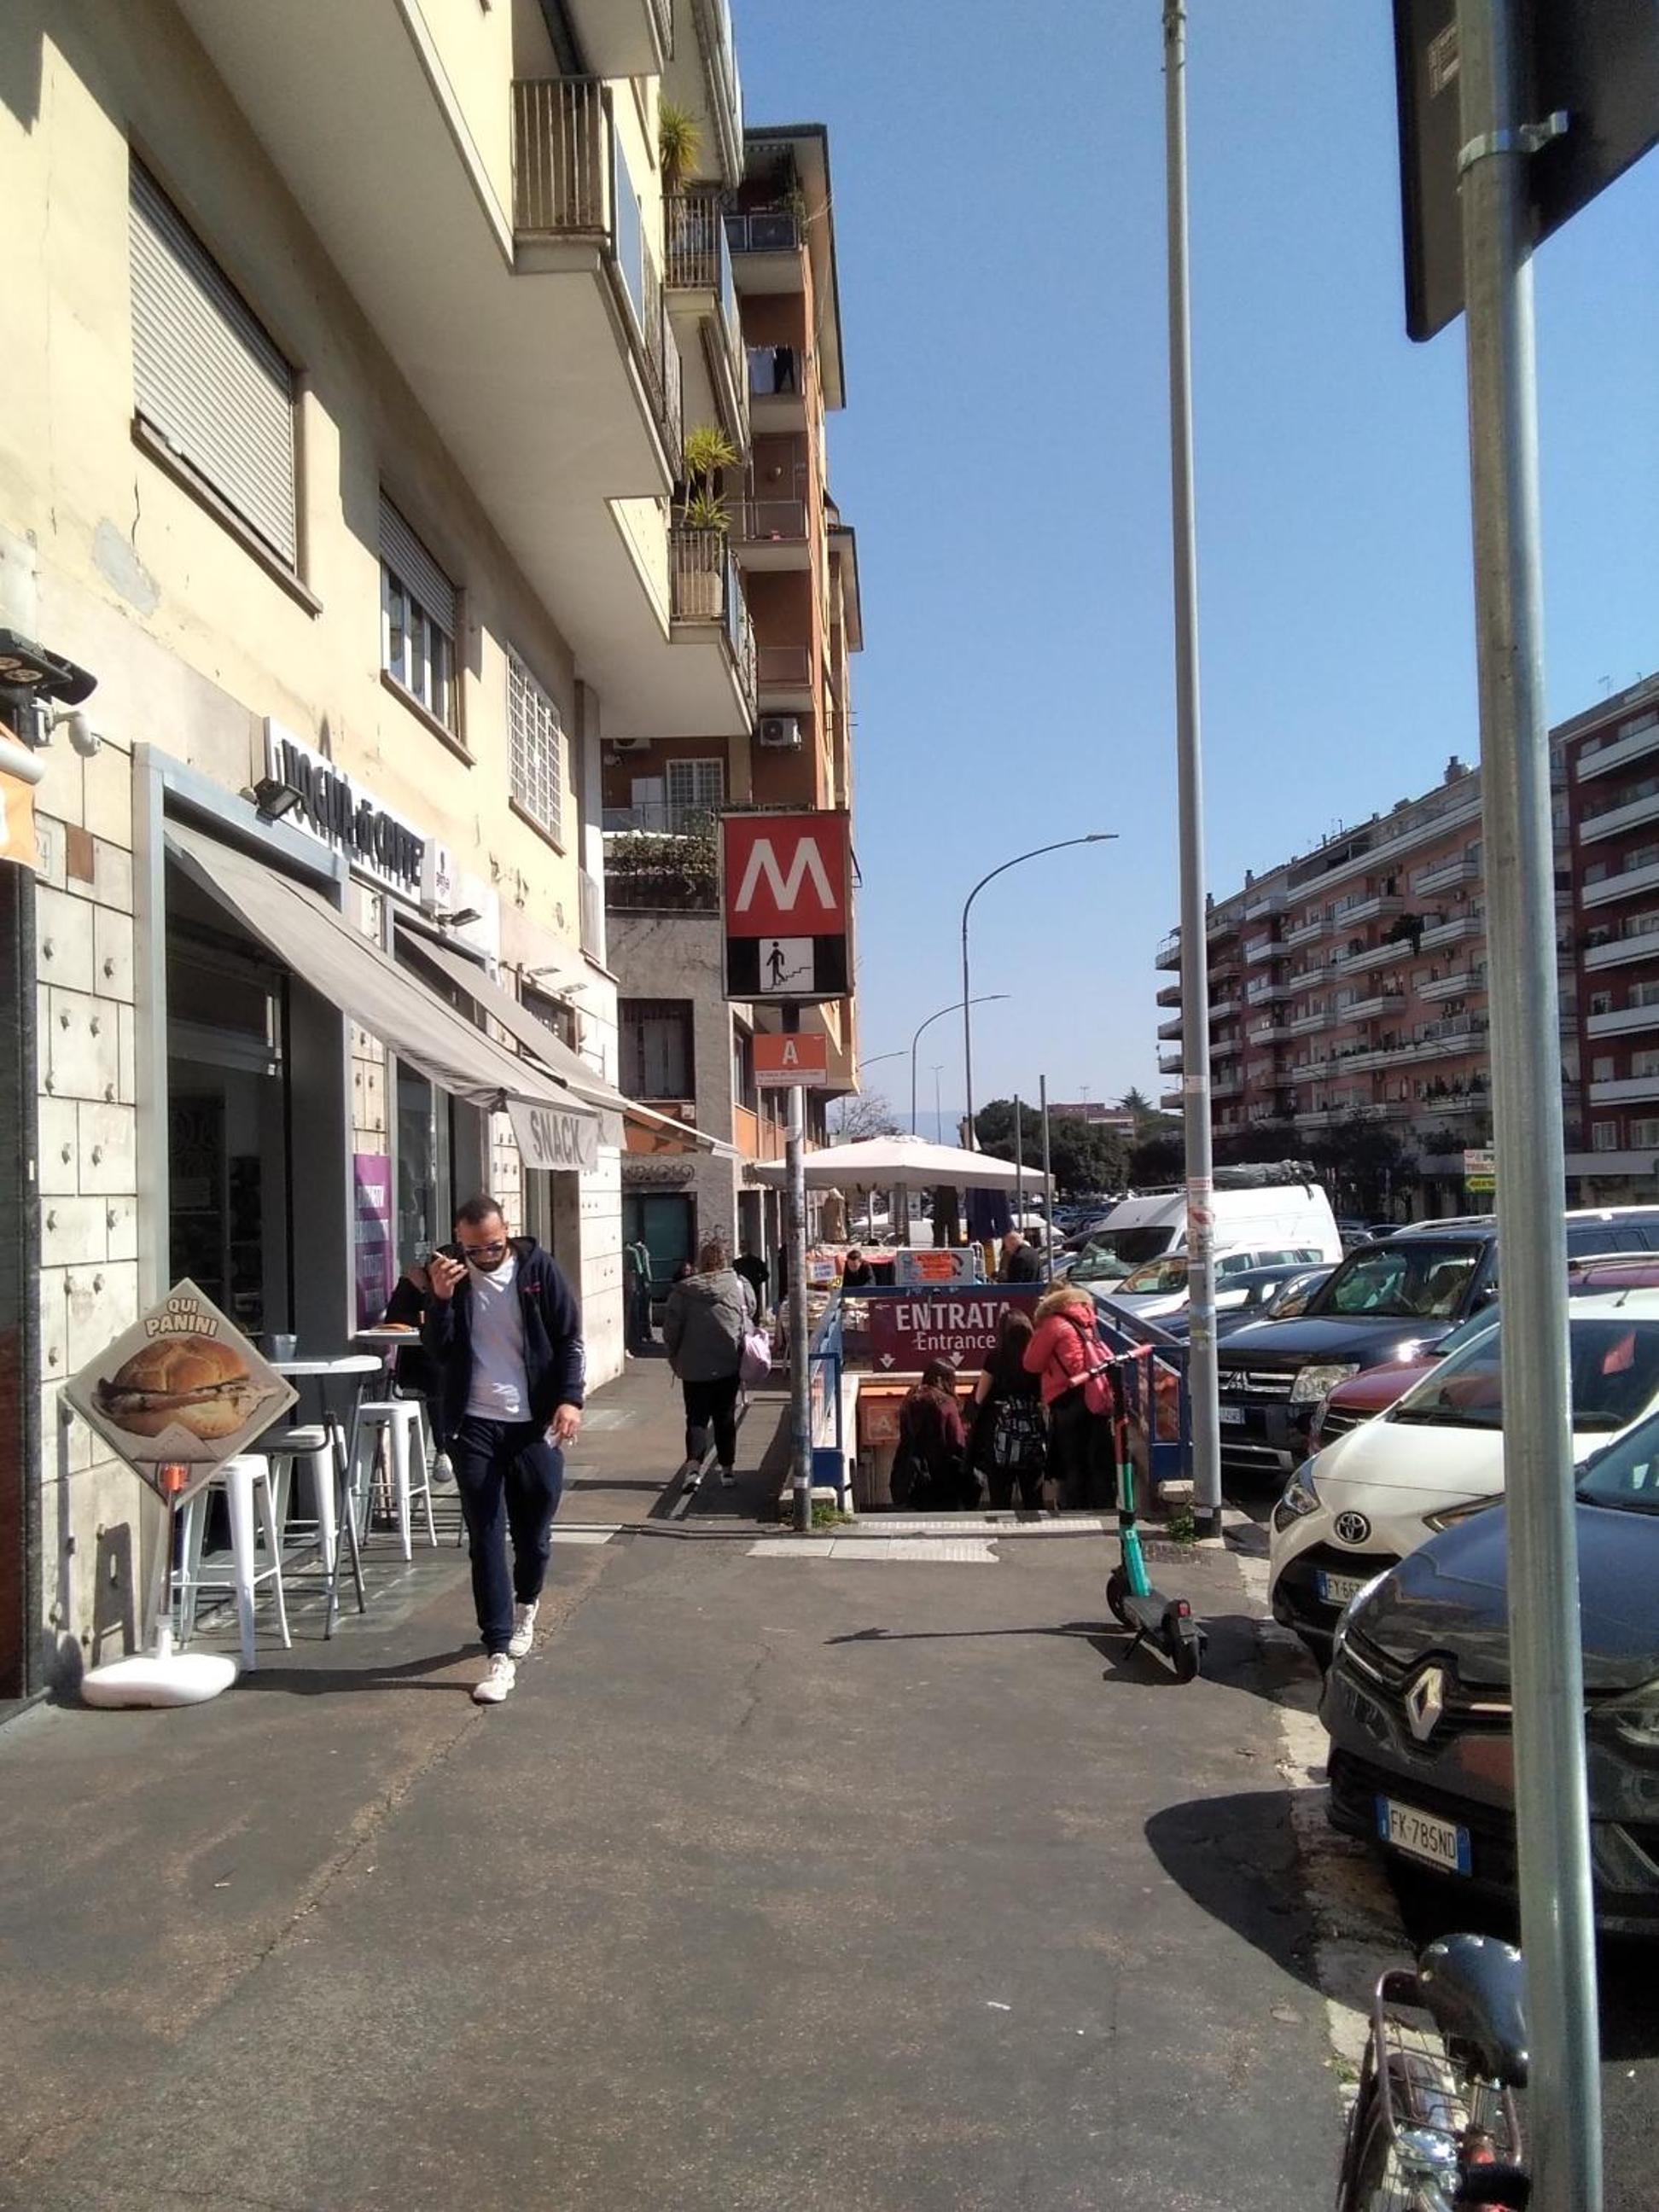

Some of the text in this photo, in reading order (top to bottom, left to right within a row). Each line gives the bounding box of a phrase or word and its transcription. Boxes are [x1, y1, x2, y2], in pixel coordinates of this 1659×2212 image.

[735, 837, 838, 911] M
[782, 1039, 799, 1066] A
[530, 1109, 585, 1165] SNACK
[167, 1298, 199, 1314] QUI
[145, 1314, 218, 1337] PANINI
[916, 1331, 997, 1350] Entrance
